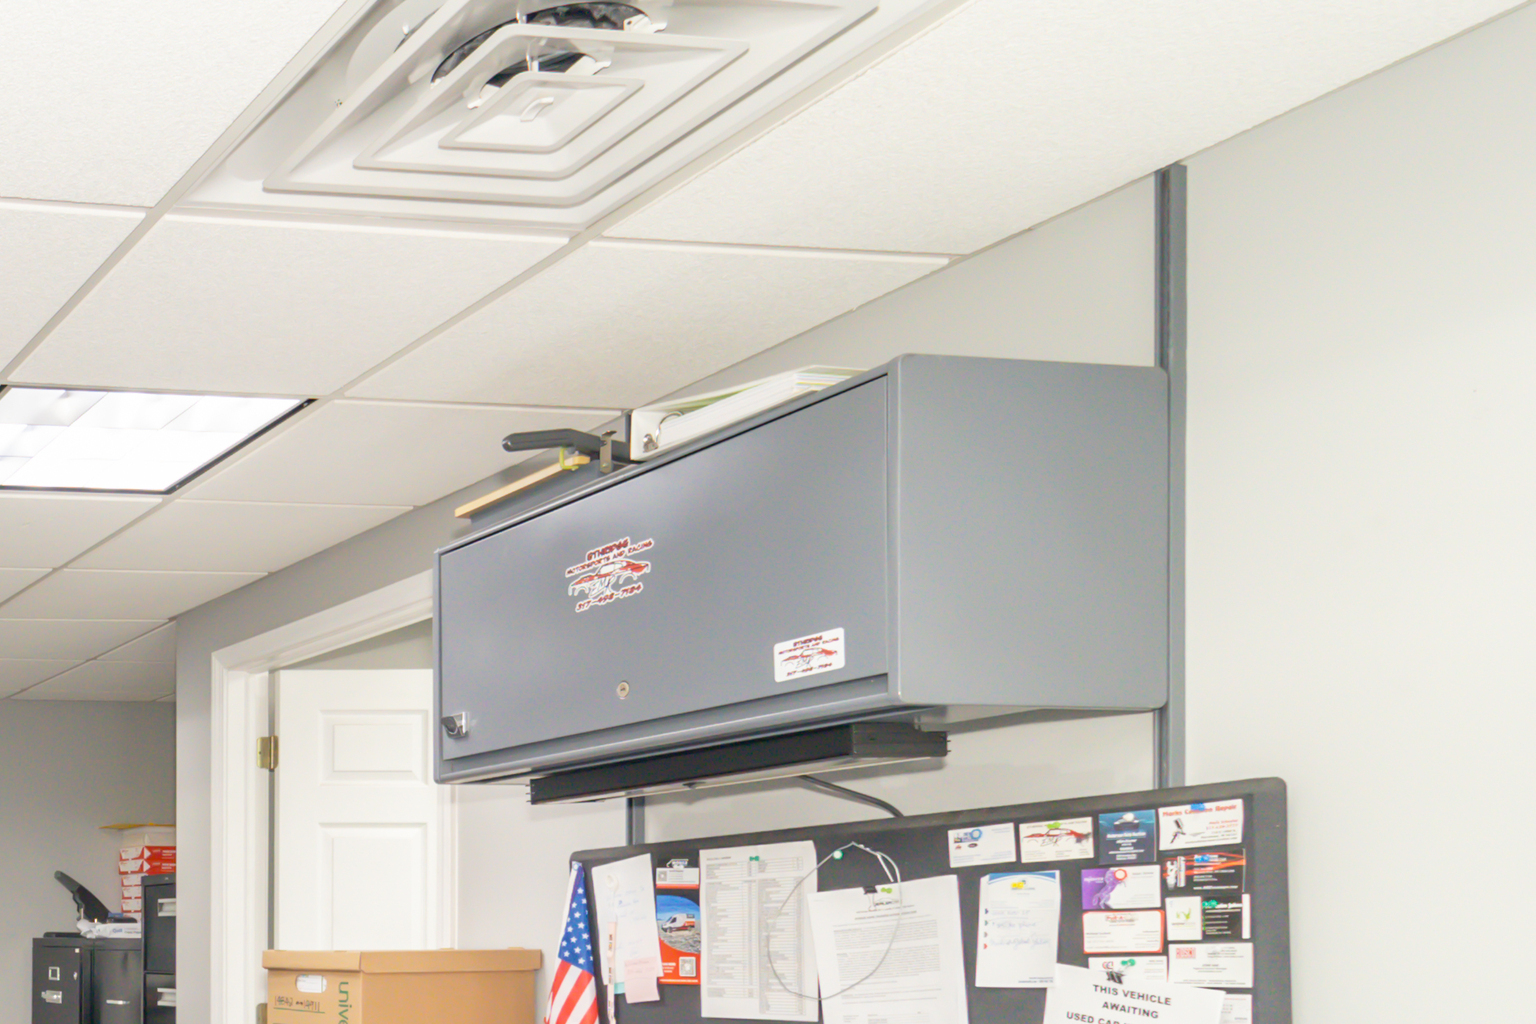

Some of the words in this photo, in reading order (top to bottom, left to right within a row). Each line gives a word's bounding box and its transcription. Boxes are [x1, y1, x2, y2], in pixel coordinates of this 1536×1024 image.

[1092, 984, 1119, 996] THIS
[1122, 988, 1173, 1006] VEHICLE
[1066, 1011, 1095, 1024] USED
[1102, 1001, 1159, 1019] AWAITING
